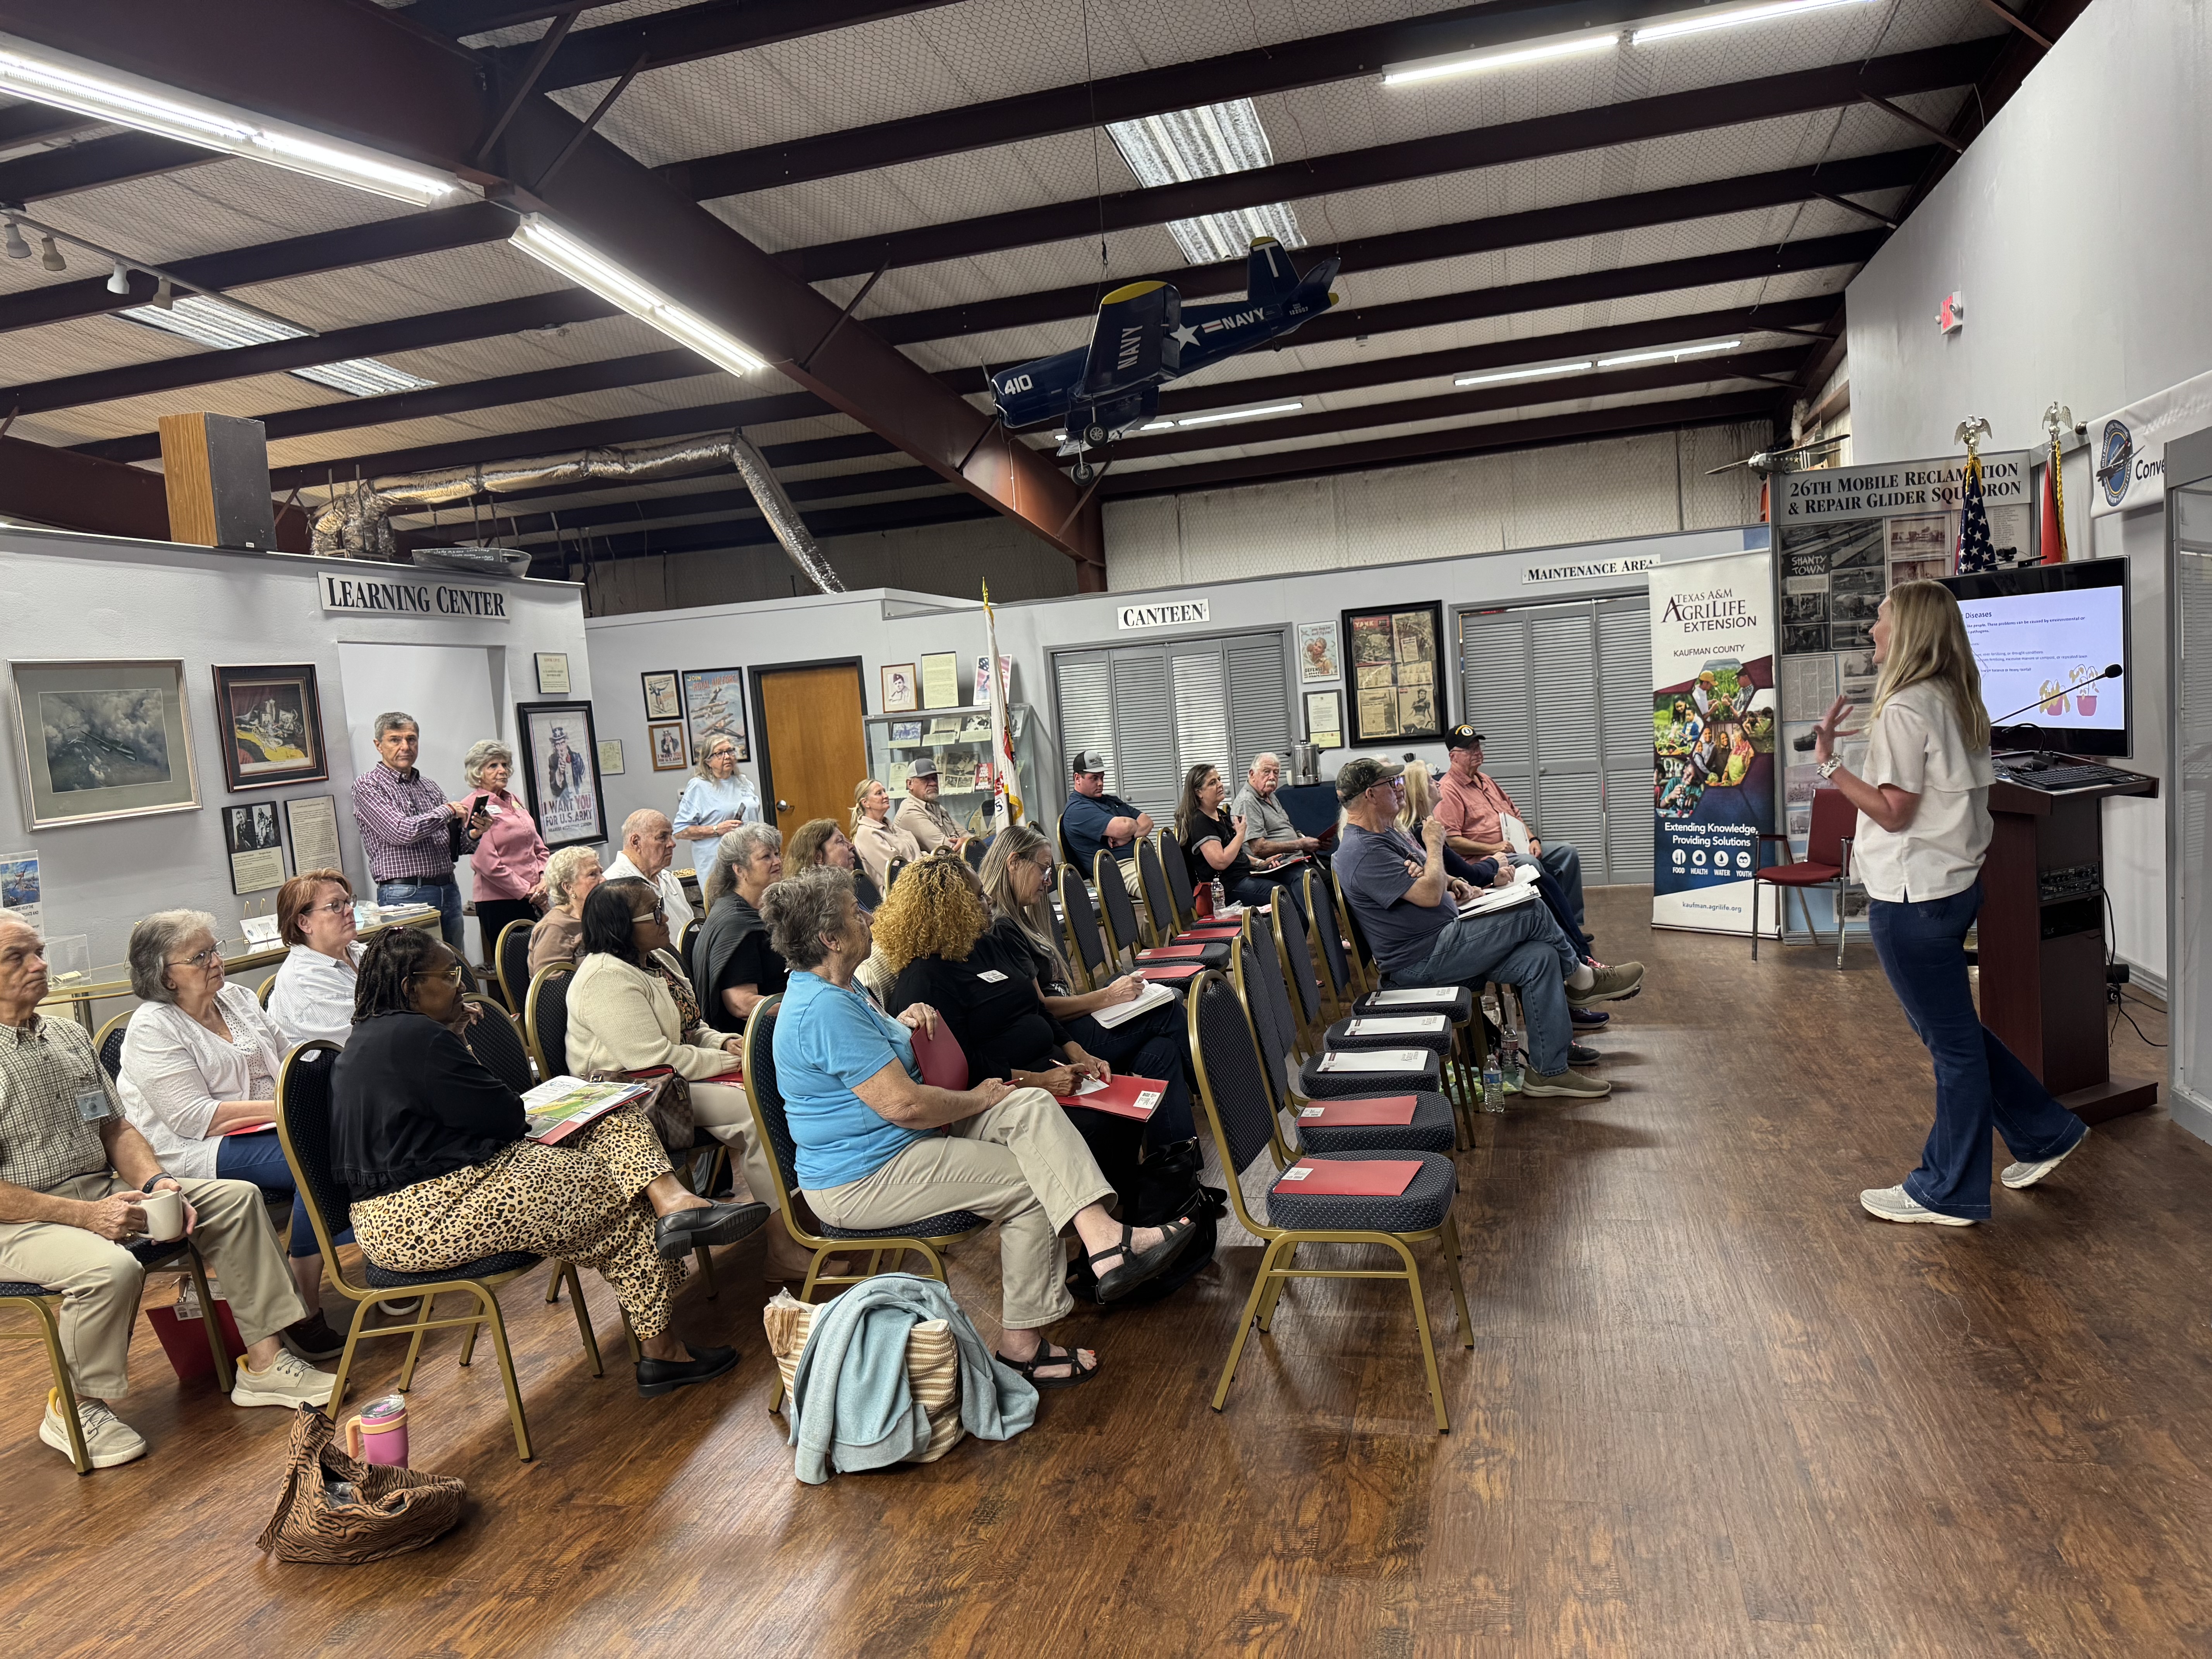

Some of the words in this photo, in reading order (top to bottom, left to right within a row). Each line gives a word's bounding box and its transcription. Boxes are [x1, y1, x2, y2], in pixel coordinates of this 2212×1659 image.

[1222, 307, 1265, 330] NAVY
[1117, 325, 1143, 370] NAVY
[1004, 374, 1034, 395] 410
[1790, 479, 1832, 498] 26TH
[1838, 474, 1899, 493] MOBILE
[1905, 462, 2019, 486] RECLAMTION
[1788, 502, 1799, 515] &
[1805, 497, 1862, 514] REPAIR
[1866, 490, 1925, 508] GLIDER
[1931, 481, 2021, 504] SQUDRON
[1791, 554, 1827, 567] SHANTY
[1528, 562, 1617, 581] MAINTENANCE
[1791, 565, 1826, 576] TOWN
[326, 577, 430, 612] LEARNING
[436, 586, 506, 617] CENTER
[1675, 592, 1705, 603] TEXAS
[1707, 587, 1732, 600] A&M
[1123, 603, 1203, 627] CANTEEN
[1684, 615, 1757, 633] EXTENSION
[1673, 647, 1711, 657] KAUFMAN
[1712, 644, 1745, 654] COUNTY
[693, 680, 710, 691] ROYAL
[544, 802, 547, 815] I
[549, 798, 573, 813] WANT
[574, 794, 592, 810] YOU
[545, 815, 558, 827] FOR
[1665, 822, 1706, 835] Extending
[1707, 823, 1759, 835] Knowledge,
[1673, 835, 1711, 848] Providing
[1712, 836, 1751, 847] Solutions
[1682, 901, 1742, 913] kaufman.agrilife.org
